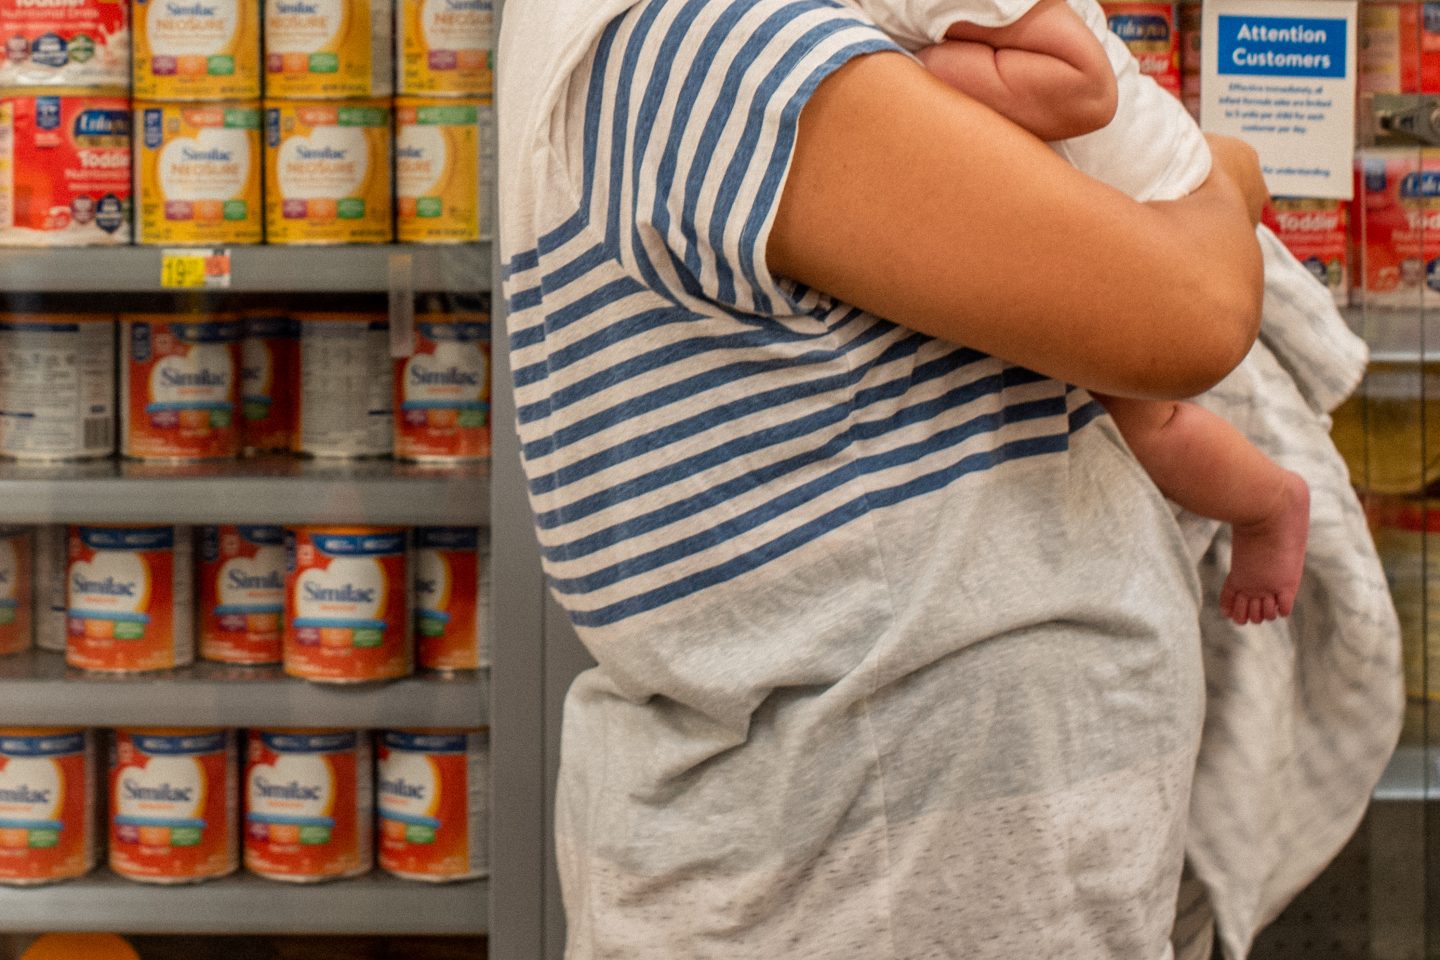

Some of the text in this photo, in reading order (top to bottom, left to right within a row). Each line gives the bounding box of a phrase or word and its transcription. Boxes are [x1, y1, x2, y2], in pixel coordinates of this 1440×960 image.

[165, 1, 217, 17] Similac
[1236, 24, 1327, 44] Attention
[1232, 48, 1331, 69] Customers
[1228, 82, 1263, 92] Effective
[1218, 95, 1241, 105] infant
[1242, 97, 1272, 106] formula
[1305, 99, 1332, 108] limited
[1260, 112, 1273, 121] per
[1241, 125, 1275, 133] customer
[1277, 126, 1290, 134] per
[181, 147, 233, 162] Similac
[296, 146, 348, 161] Similac
[1275, 167, 1331, 179] understanding
[1276, 213, 1339, 232] Toddler
[160, 366, 232, 388] Similac
[410, 364, 480, 387] Similac
[71, 572, 136, 597] Similac
[303, 579, 376, 604] Similac
[123, 778, 193, 803] Similac
[255, 776, 321, 802] Similac
